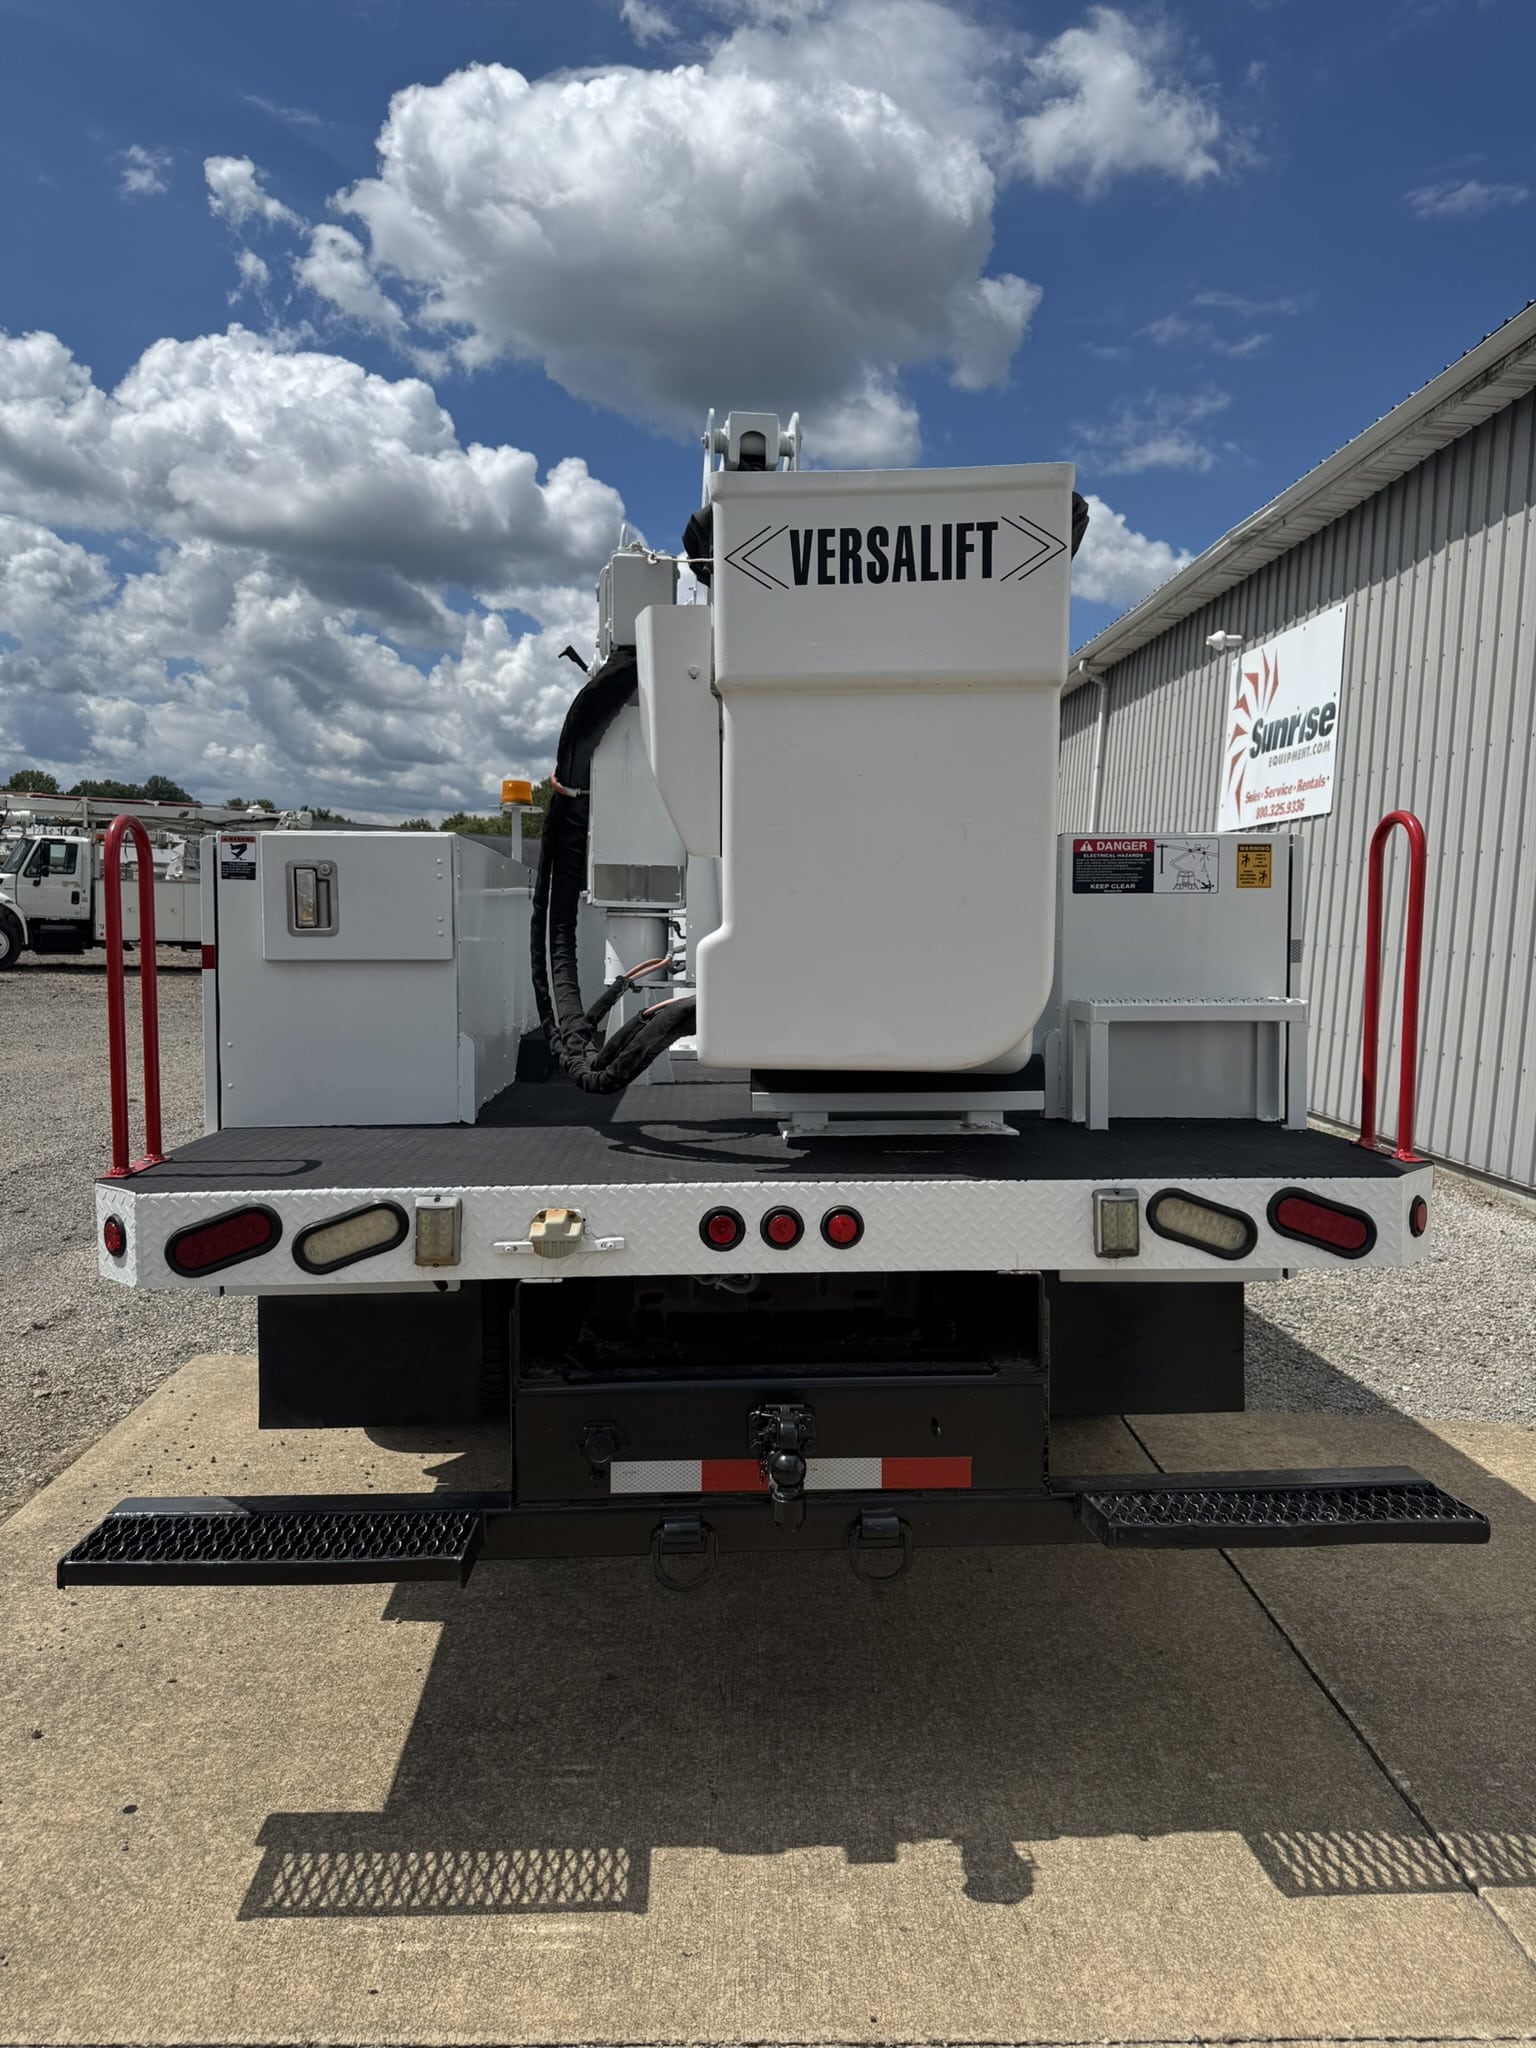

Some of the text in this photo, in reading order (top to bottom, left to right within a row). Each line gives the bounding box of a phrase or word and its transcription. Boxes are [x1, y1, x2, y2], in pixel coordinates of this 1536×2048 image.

[789, 521, 998, 586] VERSALIFT
[1250, 701, 1336, 759] Sunrise
[1268, 740, 1331, 768] EQUIPMENT.COM
[1096, 841, 1148, 851] DANGER
